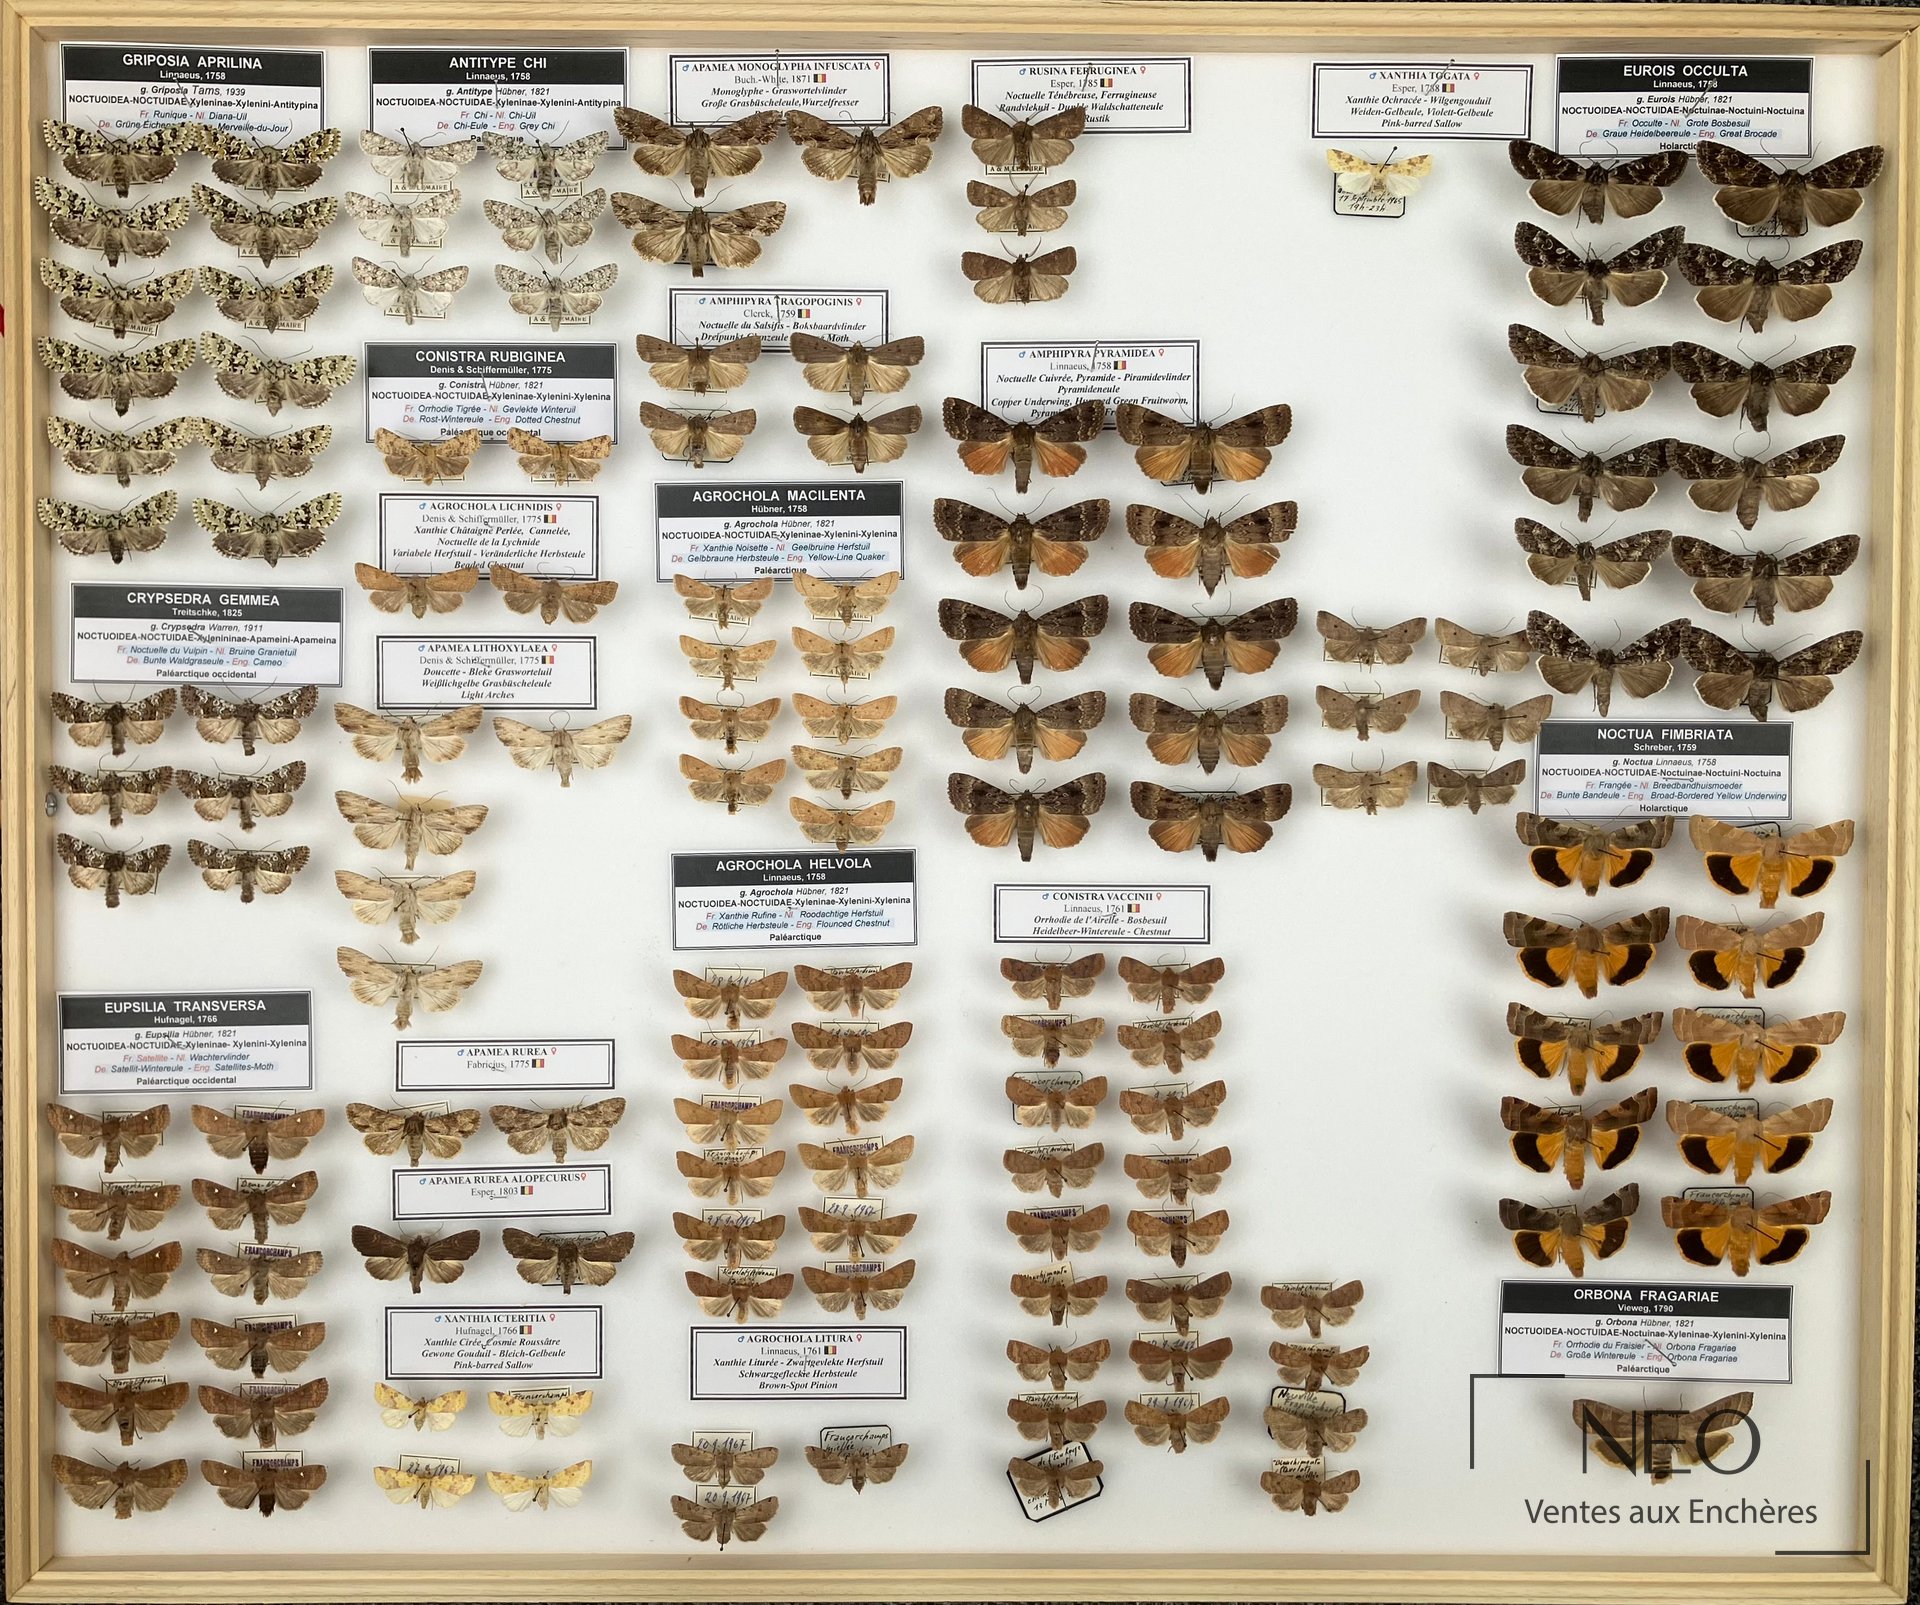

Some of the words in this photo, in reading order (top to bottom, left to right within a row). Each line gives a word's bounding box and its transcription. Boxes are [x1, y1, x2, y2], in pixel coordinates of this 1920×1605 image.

[123, 54, 189, 67] GRIPOSIA
[197, 55, 262, 69] APRILINA
[449, 57, 516, 69] ANTITYPE
[524, 58, 547, 68] CHI
[737, 63, 811, 71] MONOGLYPHA
[814, 62, 871, 71] INFUSCATA
[1030, 67, 1067, 75] RUSINA
[1070, 67, 1137, 75] FERRUGINEA
[1624, 66, 1675, 77] EUROIS
[1683, 65, 1748, 77] OCCULTA
[160, 70, 202, 80] Linnaeus,
[205, 72, 226, 80] 1758
[466, 73, 508, 81] Linnaeus,
[1430, 72, 1470, 80] TOGATA
[1392, 85, 1417, 93] Esper,
[1654, 80, 1696, 89] Linnaeus,
[151, 85, 188, 96] Griposia
[192, 85, 221, 96] Tams,
[226, 87, 245, 96] 1939
[1006, 92, 1046, 100] Noctuelle
[1048, 91, 1098, 100] Ténébreuse,
[1101, 91, 1157, 100] Ferrugineuse
[1351, 108, 1424, 116] Weiden-Gelbeule,
[1427, 108, 1493, 117] Violett-Gelbeule
[1381, 119, 1432, 128] Pink-barred
[1434, 119, 1462, 128] Sallow
[710, 297, 772, 305] AMPHIPYRA
[774, 298, 853, 306] RAGOPOGINIS
[416, 351, 486, 362] CONISTRA
[491, 351, 565, 362] RUBIGINEA
[1030, 350, 1091, 358] AMPHIPYRA
[1095, 349, 1155, 358] PYRAMIDEA
[430, 366, 455, 374] Denis
[457, 366, 464, 374] &
[466, 365, 529, 375] Schiffermüller,
[532, 366, 552, 374] 1775
[439, 382, 446, 390] g.
[489, 382, 520, 390] Hübner,
[1058, 386, 1120, 394] Pyramideneule
[693, 491, 779, 502] AGROCHOLA
[787, 490, 865, 501] MACILENTA
[430, 503, 496, 511] AGROCHOLA
[500, 503, 553, 511] LICHNIDIS
[752, 505, 785, 514] Hübner,
[788, 505, 807, 513] 1758
[422, 515, 446, 523] Denis
[459, 515, 519, 524] Schiffermüller,
[734, 520, 778, 529] Agrochola
[781, 520, 813, 528] Hübner,
[816, 520, 835, 528] 1821
[414, 526, 447, 535] Xanthie
[450, 526, 493, 535] Châtaigne
[495, 526, 524, 535] Perlée,
[529, 526, 570, 536] Cannelée,
[437, 538, 476, 546] Noctuelle
[479, 538, 489, 546] de
[491, 538, 499, 546] la
[502, 538, 540, 547] Lychnide
[128, 593, 211, 604] CRYPSEDRA
[219, 594, 279, 606] GEMMEA
[173, 608, 219, 617] Treitschke,
[222, 609, 242, 617] 1825
[473, 644, 548, 652] LITHOXYLAEA
[157, 669, 209, 680] Paléarctique
[212, 670, 256, 679] occidental
[422, 679, 480, 689] Weißlichgelbe
[482, 679, 552, 688] Grasbüscheleule
[461, 691, 484, 700] Light
[485, 691, 514, 699] Arches
[1598, 729, 1653, 740] NOCTUA
[1662, 729, 1733, 740] FIMBRIATA
[1634, 743, 1674, 752] Schreber,
[1623, 758, 1653, 766] Noctua
[1656, 758, 1693, 767] Linnaeus,
[1640, 804, 1688, 813] Holarctique
[716, 859, 802, 871] AGROCHOLA
[810, 858, 871, 870] HELVOLA
[763, 873, 804, 882] Linnaeus,
[806, 873, 825, 881] 1758
[1053, 893, 1104, 901] CONISTRA
[1107, 893, 1153, 901] VACCINII
[1064, 905, 1103, 913] Linnaeus,
[1106, 905, 1125, 913] 1761
[770, 932, 821, 943] Paléarctique
[105, 1002, 166, 1013] EUPSILIA
[174, 1000, 266, 1012] TRANSVERSA
[154, 1015, 195, 1025] Hufnagel,
[197, 1015, 217, 1023] 1766
[467, 1048, 510, 1057] APAMEA
[512, 1048, 547, 1056] RUREA
[467, 1060, 507, 1070] Fabricius,
[510, 1060, 529, 1068] 1775
[137, 1076, 190, 1087] Paléarctique
[192, 1076, 236, 1085] occidental
[429, 1176, 471, 1185] APAMEA
[474, 1175, 509, 1184] RUREA
[511, 1173, 581, 1183] ALOPECURUS
[471, 1187, 496, 1197] Esper,
[499, 1187, 518, 1196] 1803
[1574, 1289, 1632, 1301] ORBONA
[1640, 1290, 1719, 1302] FRAGARIAE
[1618, 1304, 1651, 1313] Vieweg,
[1653, 1305, 1673, 1313] 1790
[445, 1315, 491, 1323] XANTHIA
[1595, 1319, 1603, 1327] g.
[1606, 1318, 1637, 1326] Orbona
[1640, 1318, 1671, 1328] Hübner,
[1675, 1319, 1694, 1328] 1821
[456, 1327, 495, 1336] Hufnagel,
[498, 1327, 518, 1335] 1766
[747, 1335, 813, 1343] AGROCHOLA
[815, 1335, 853, 1343] LITURA
[761, 1347, 800, 1356] Linnaeus,
[803, 1347, 821, 1355] 1761
[453, 1361, 503, 1370] Pink-barred
[505, 1361, 533, 1369] Sallow
[1617, 1364, 1670, 1374] Paléarctique
[759, 1382, 808, 1390] Brown-Spot
